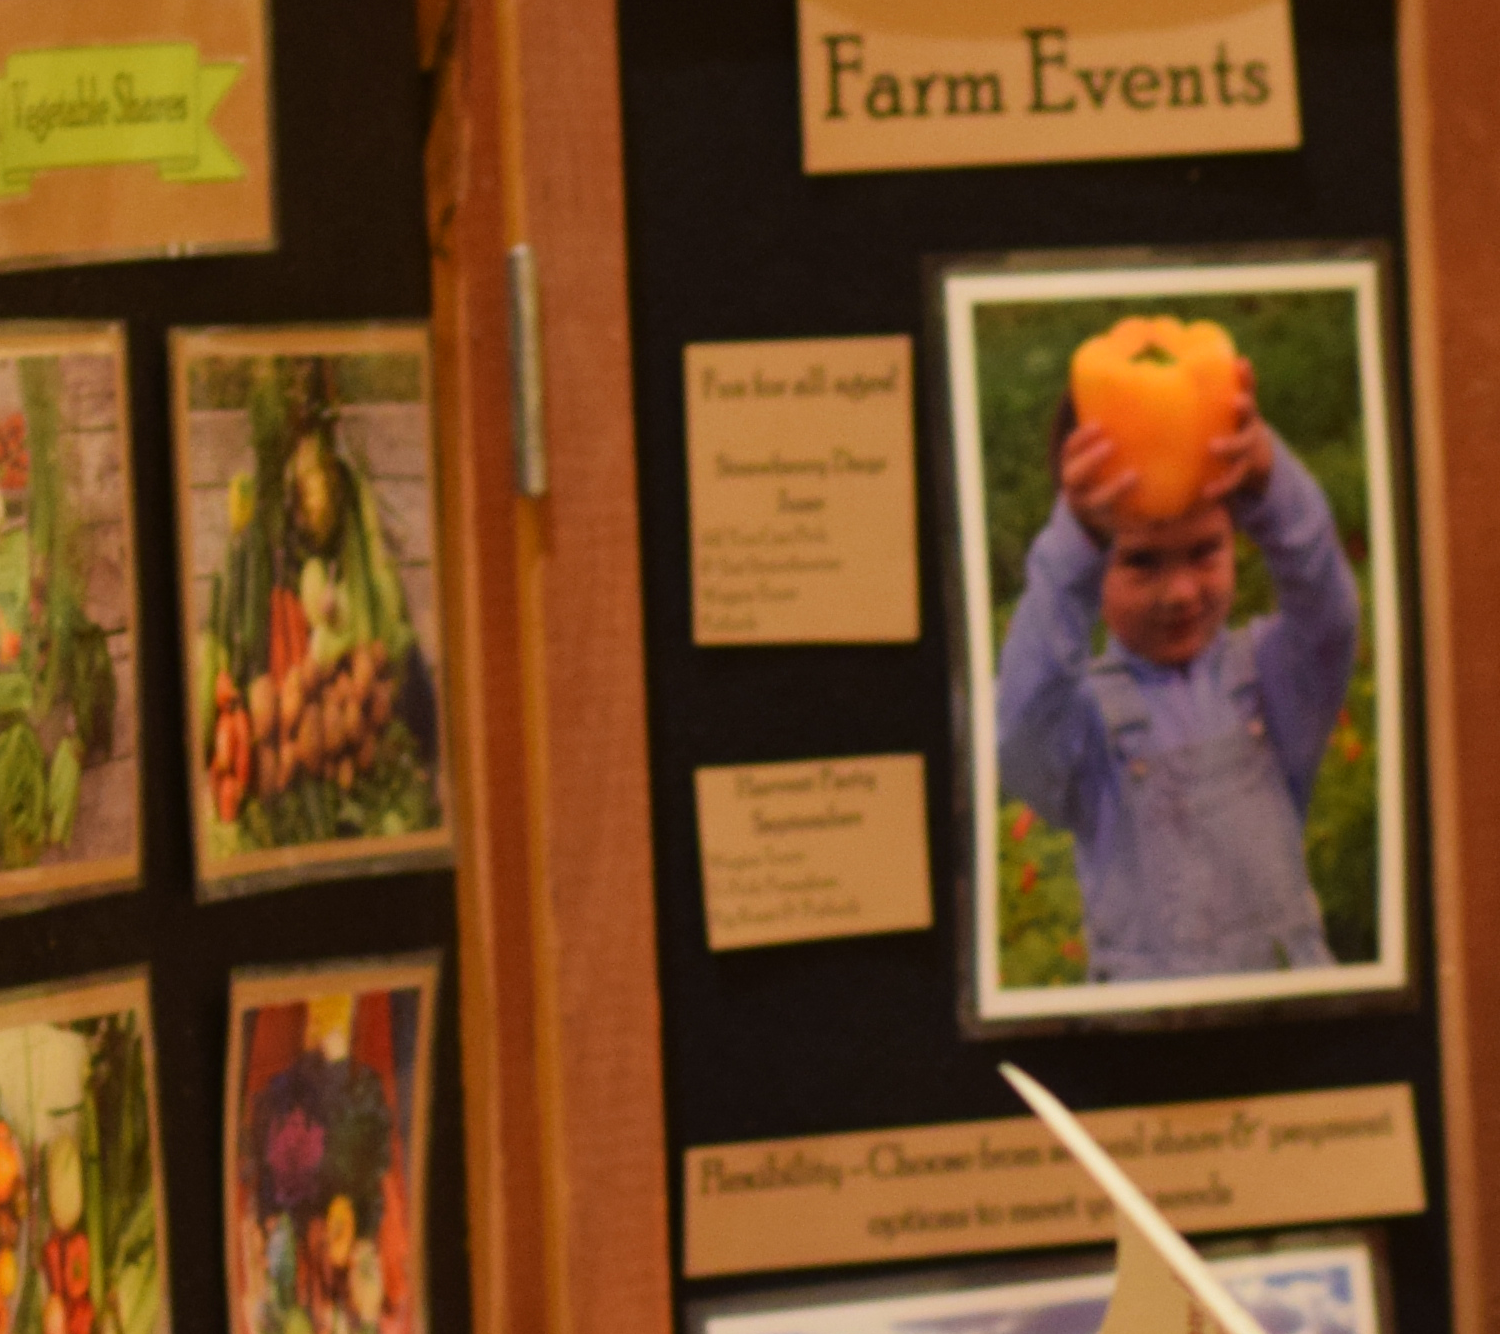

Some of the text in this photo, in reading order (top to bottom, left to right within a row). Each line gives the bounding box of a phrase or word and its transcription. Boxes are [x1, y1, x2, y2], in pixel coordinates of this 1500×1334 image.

[113, 70, 189, 125] Shares
[821, 25, 1271, 121] Farm Events
[700, 1155, 843, 1195] Flexibility
[867, 1142, 972, 1179] Choose
[976, 1136, 1042, 1169] from
[865, 1209, 970, 1243] options
[973, 1201, 1000, 1227] to
[1008, 1197, 1077, 1224] meet
